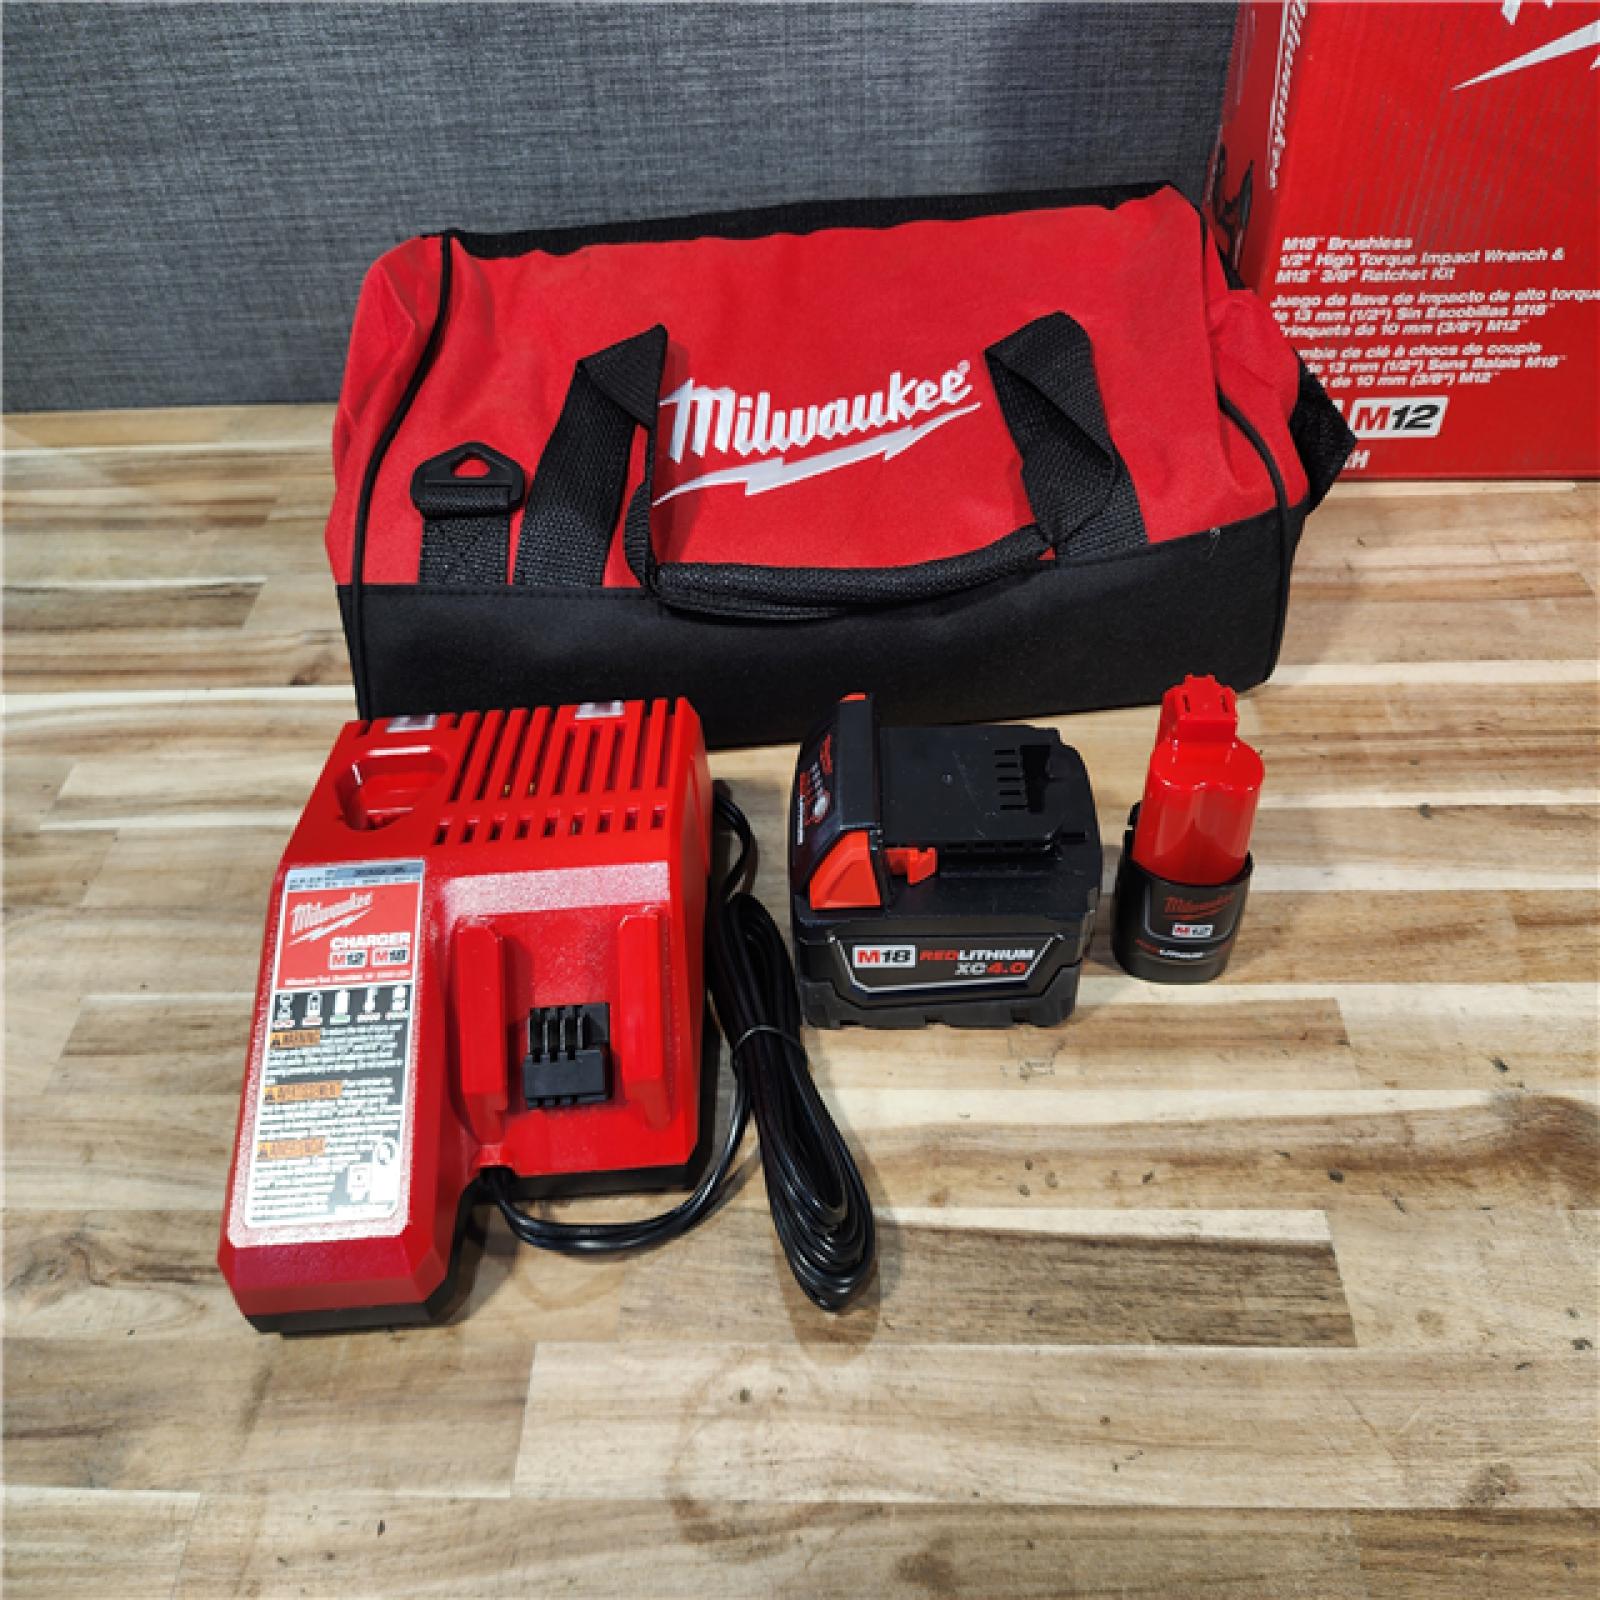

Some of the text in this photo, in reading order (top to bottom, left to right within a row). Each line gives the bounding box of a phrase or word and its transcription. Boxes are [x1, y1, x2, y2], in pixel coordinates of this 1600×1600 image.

[1327, 236, 1413, 250] Brushless
[1315, 252, 1354, 268] High
[1360, 252, 1416, 268] Torque
[1420, 249, 1480, 266] Impact
[1485, 248, 1548, 263] Wrench
[1552, 247, 1565, 260] &
[1360, 268, 1428, 282] Ratchet
[1431, 267, 1455, 280] Kit
[1325, 293, 1347, 306] de
[1350, 292, 1389, 306] llave
[1392, 291, 1415, 306] de
[1418, 290, 1485, 308] impacto
[1490, 289, 1510, 303] de
[1515, 287, 1546, 302] alto
[1315, 311, 1346, 322] mm
[1396, 308, 1421, 320] Sin
[1425, 304, 1508, 318] Escobillas
[1354, 323, 1376, 336] de
[1381, 323, 1400, 336] 10
[1402, 324, 1433, 335] mm
[1341, 346, 1362, 358] de
[1409, 344, 1458, 358] chocs
[1462, 342, 1483, 355] de
[1487, 342, 1542, 355] couple
[1350, 362, 1378, 373] mm
[1428, 358, 1468, 371] Sans
[1471, 356, 1521, 370] Balais
[1330, 375, 1352, 388] de
[1377, 375, 1407, 386] mm
[1354, 404, 1439, 430] M12
[330, 932, 410, 950] CHARGER
[857, 949, 911, 963] M18
